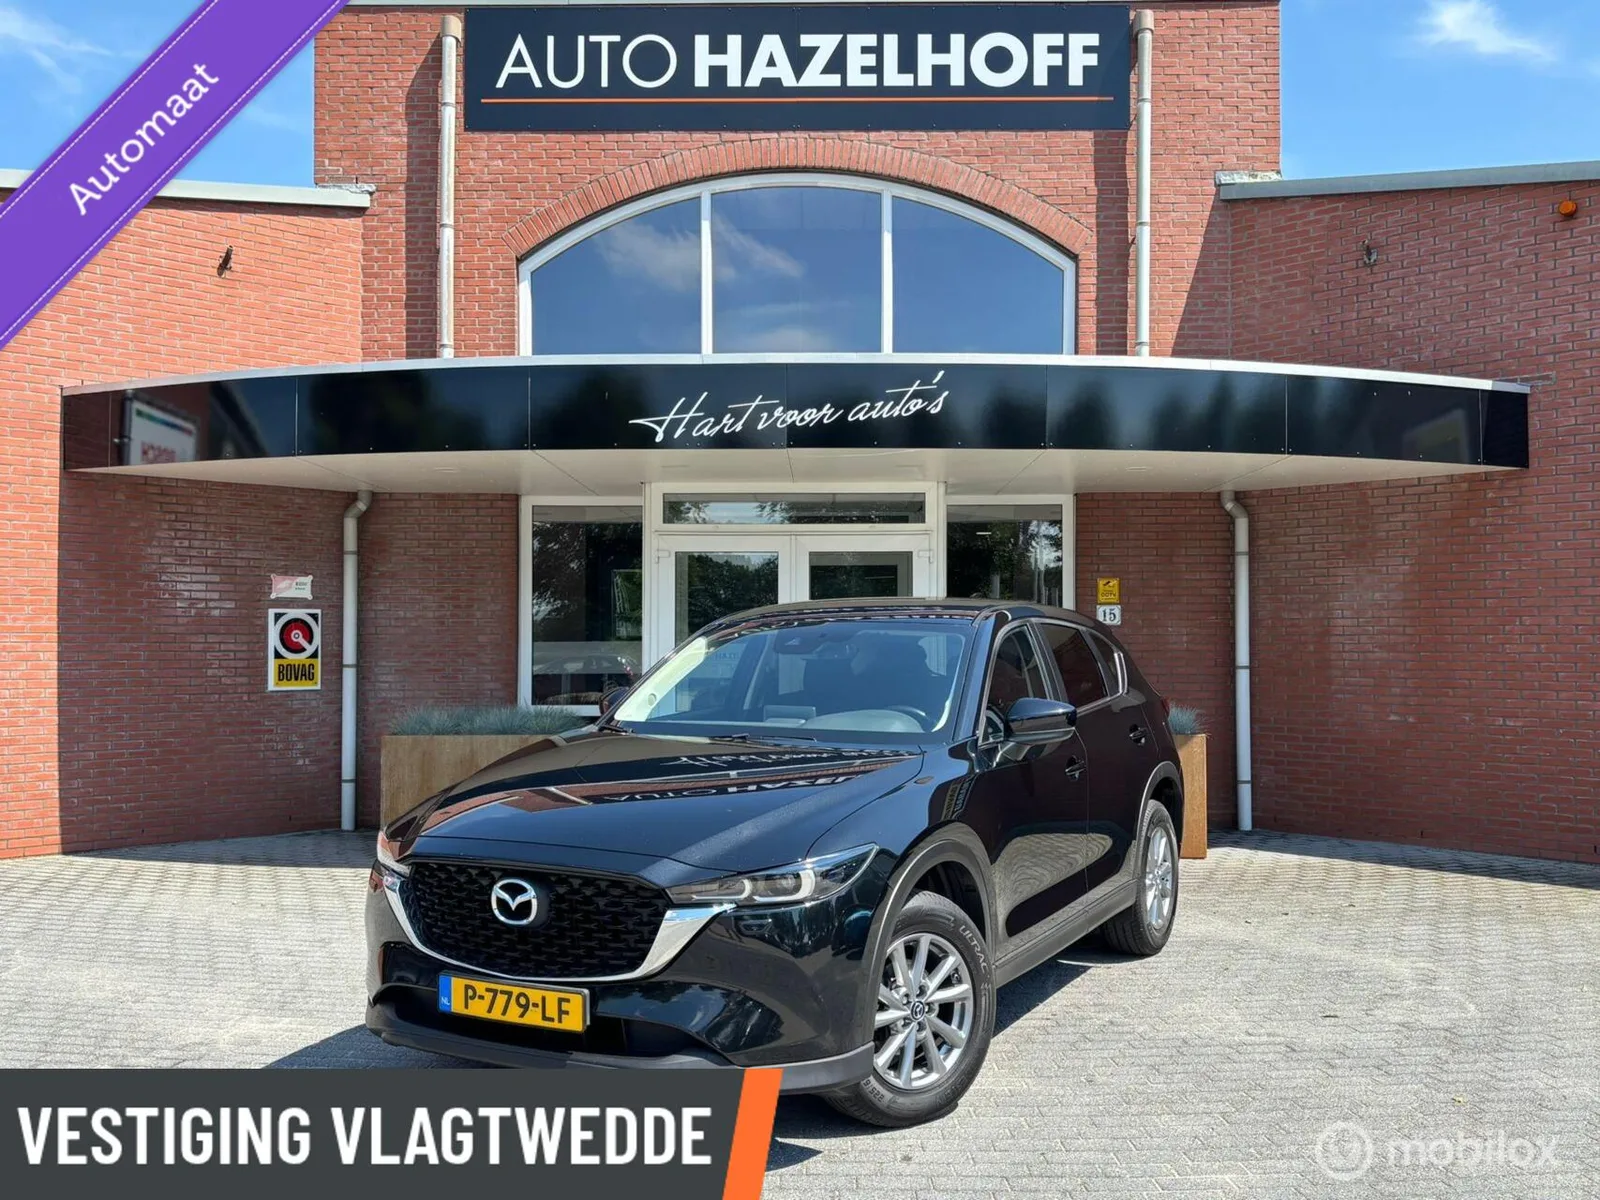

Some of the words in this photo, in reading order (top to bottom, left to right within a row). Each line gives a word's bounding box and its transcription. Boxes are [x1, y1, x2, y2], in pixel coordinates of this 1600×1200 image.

[495, 33, 678, 89] AUTO
[694, 31, 1100, 88] HAZELHOFF
[628, 391, 780, 443] Hart
[757, 402, 842, 430] voor
[847, 370, 950, 422] auto's
[1102, 608, 1117, 622] 15
[277, 663, 315, 682] BOVAG
[959, 924, 987, 974] ULTRAC
[441, 996, 451, 1006] NL
[463, 983, 571, 1024] P-779-LF
